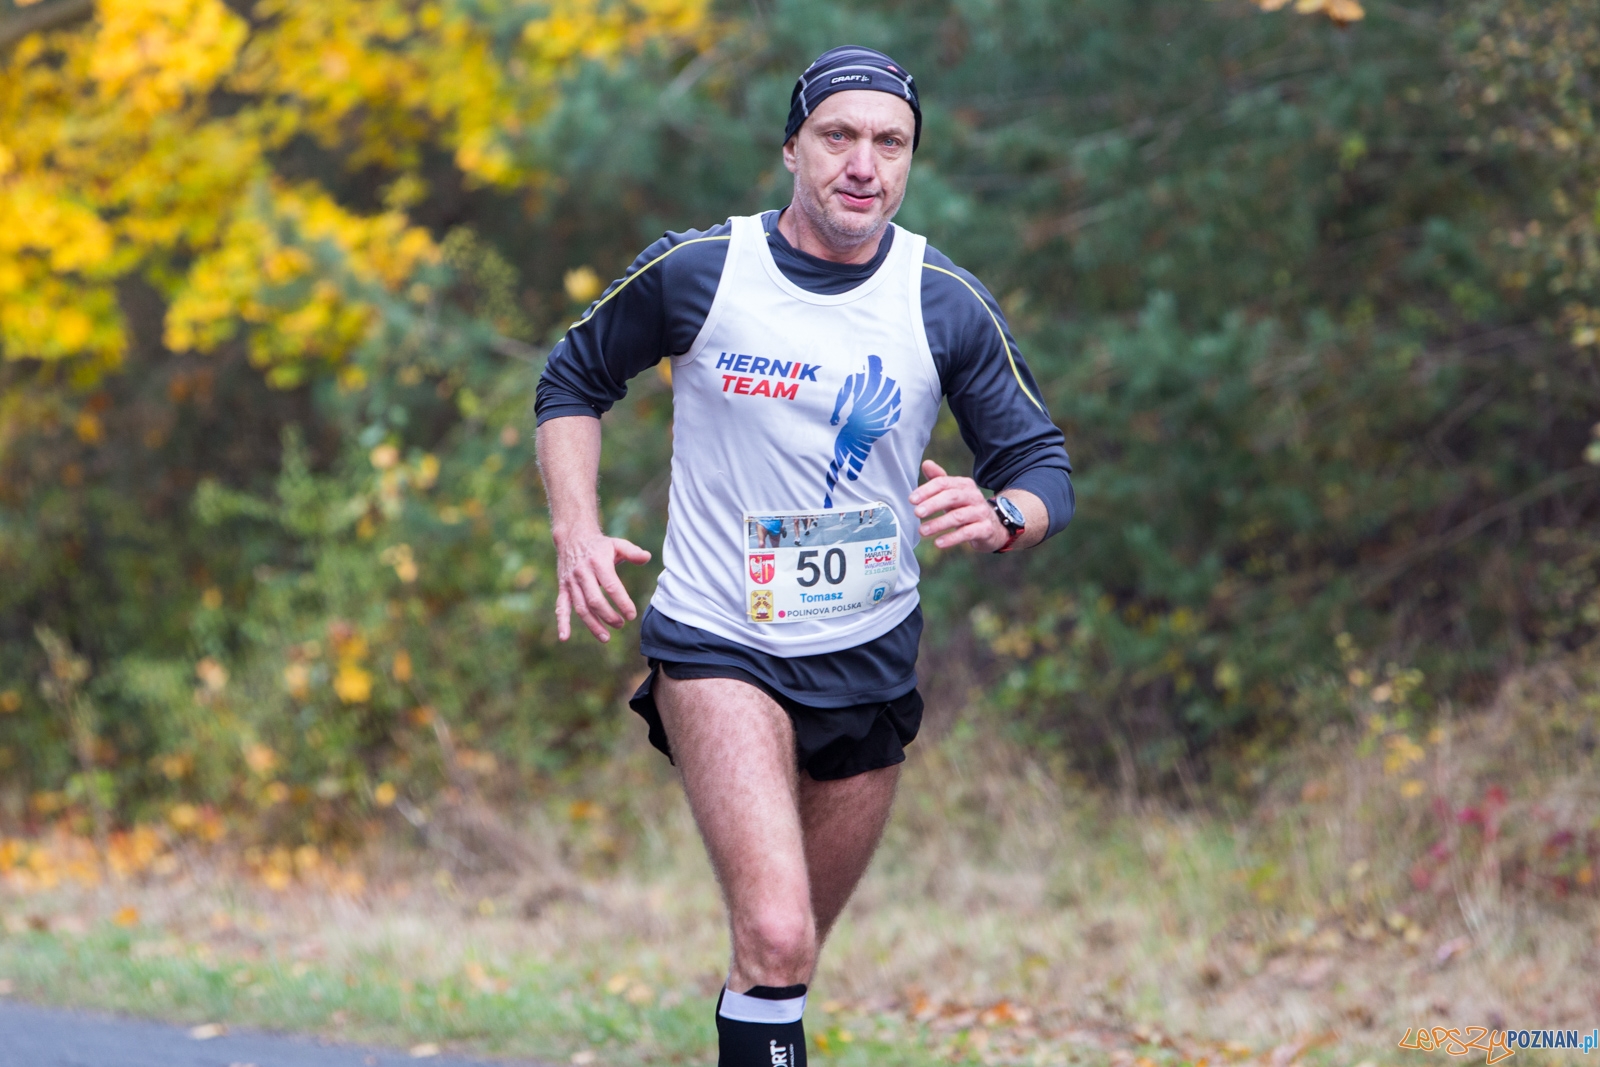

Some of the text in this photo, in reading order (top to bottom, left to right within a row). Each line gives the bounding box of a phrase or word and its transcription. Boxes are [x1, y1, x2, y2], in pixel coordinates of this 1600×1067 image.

[831, 75, 861, 83] CRAFT
[716, 352, 822, 382] HERNIK
[722, 375, 799, 400] TEAM
[796, 548, 846, 587] 50
[800, 592, 843, 603] Tomasz
[787, 602, 861, 617] POLINOVA POLSKA
